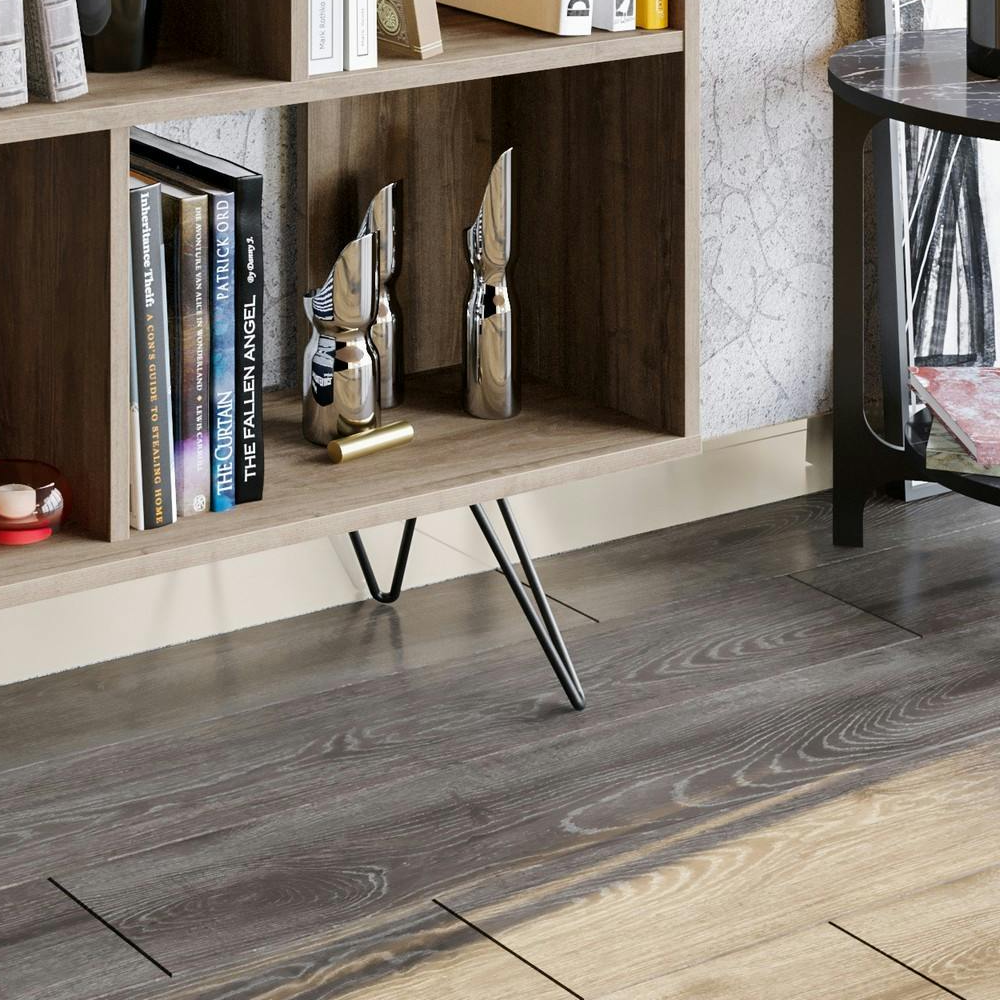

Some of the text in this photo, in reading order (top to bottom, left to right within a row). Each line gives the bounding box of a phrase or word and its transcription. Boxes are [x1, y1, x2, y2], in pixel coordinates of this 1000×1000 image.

[195, 272, 203, 290] VAN
[216, 199, 230, 301] PATRICK ORD
[140, 192, 164, 524] Inheritance Theif: A CON'S GUIDE TO STEALING HOME
[196, 317, 203, 327] IN
[243, 294, 257, 482] THE FALLEN ANGEL
[214, 390, 233, 496] THE CURTAIN
